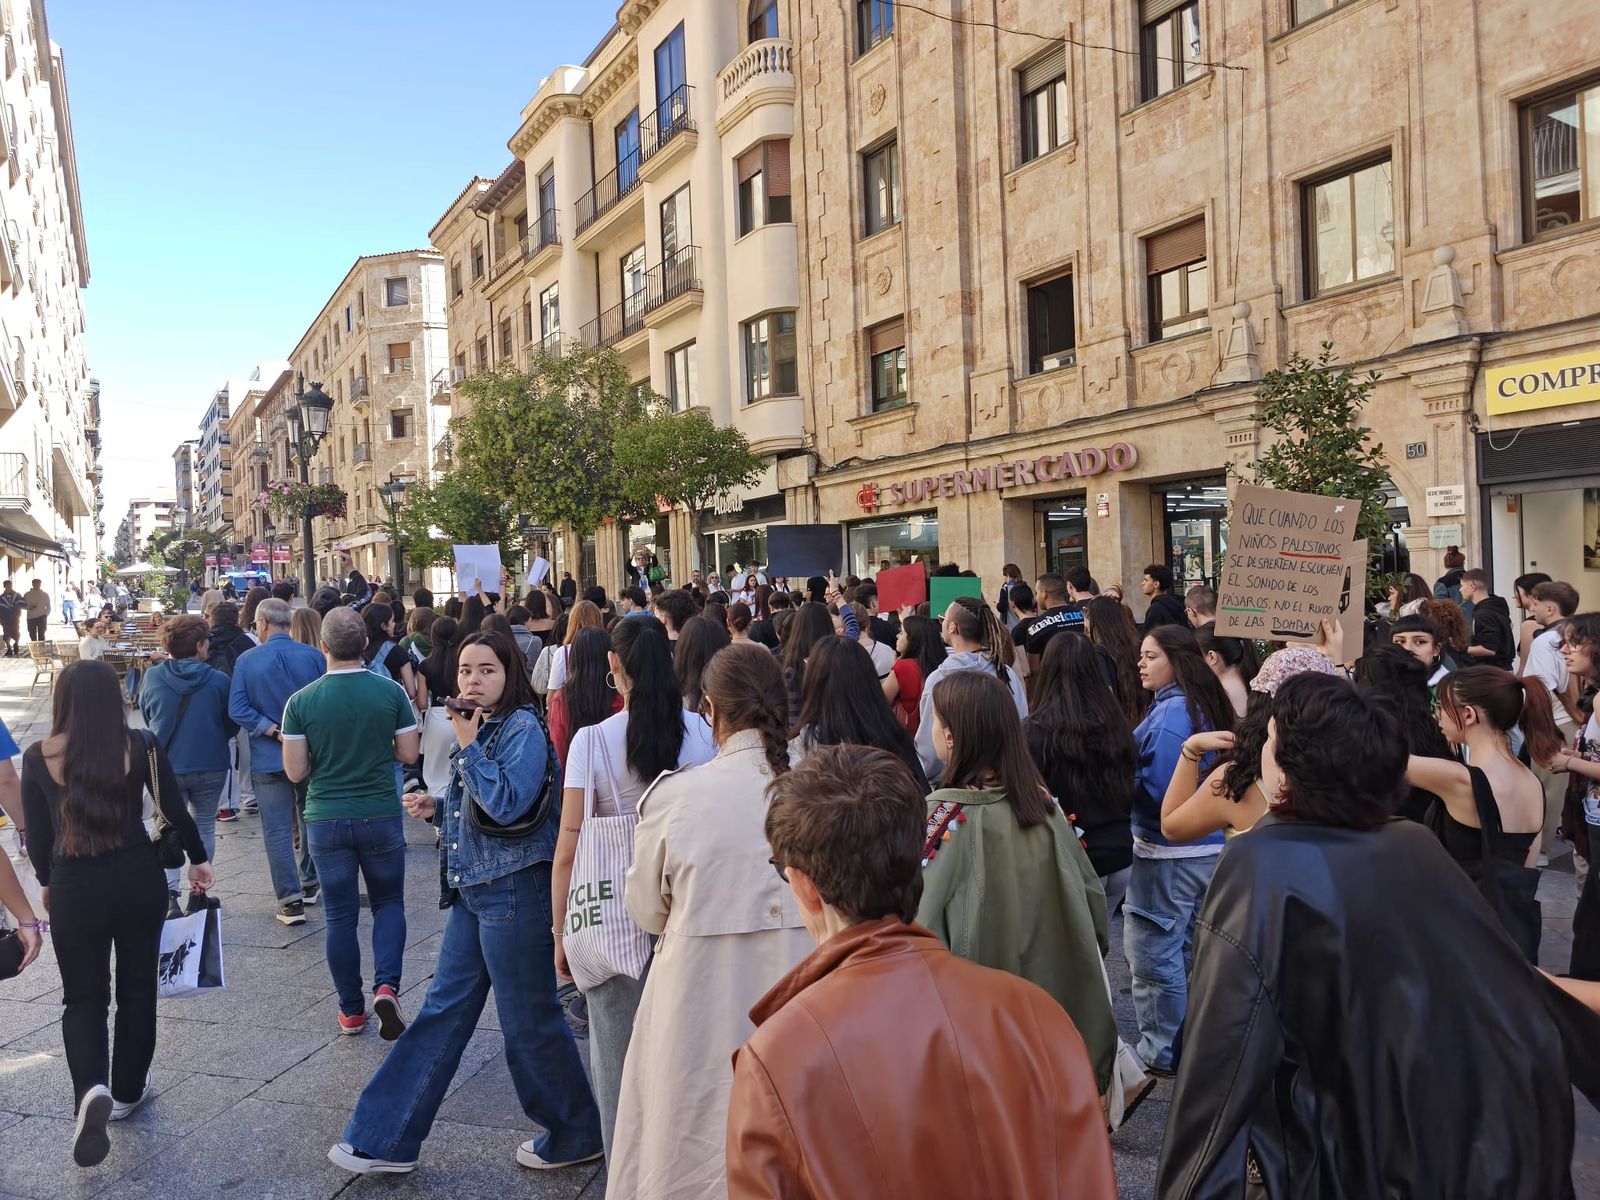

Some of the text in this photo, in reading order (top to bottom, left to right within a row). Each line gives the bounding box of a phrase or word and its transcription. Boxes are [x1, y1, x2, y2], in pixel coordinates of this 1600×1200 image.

[1407, 443, 1425, 457] 50
[890, 441, 1138, 507] SUPERMERCADO
[714, 494, 744, 515] Alberto
[1242, 503, 1344, 534] QUE CUANDO LOS
[1239, 534, 1341, 556] NIÑOS PALESTINOS
[1229, 554, 1243, 568] SE
[1300, 561, 1344, 577] ESCUCHEN
[1228, 573, 1319, 595] EL SONIDO DE LOS
[1274, 600, 1290, 611] NO
[1293, 600, 1303, 612] EL
[1309, 603, 1333, 615] RUIDO
[1229, 615, 1239, 627] DE
[1245, 616, 1265, 628] LAS
[571, 905, 603, 933] DIE
